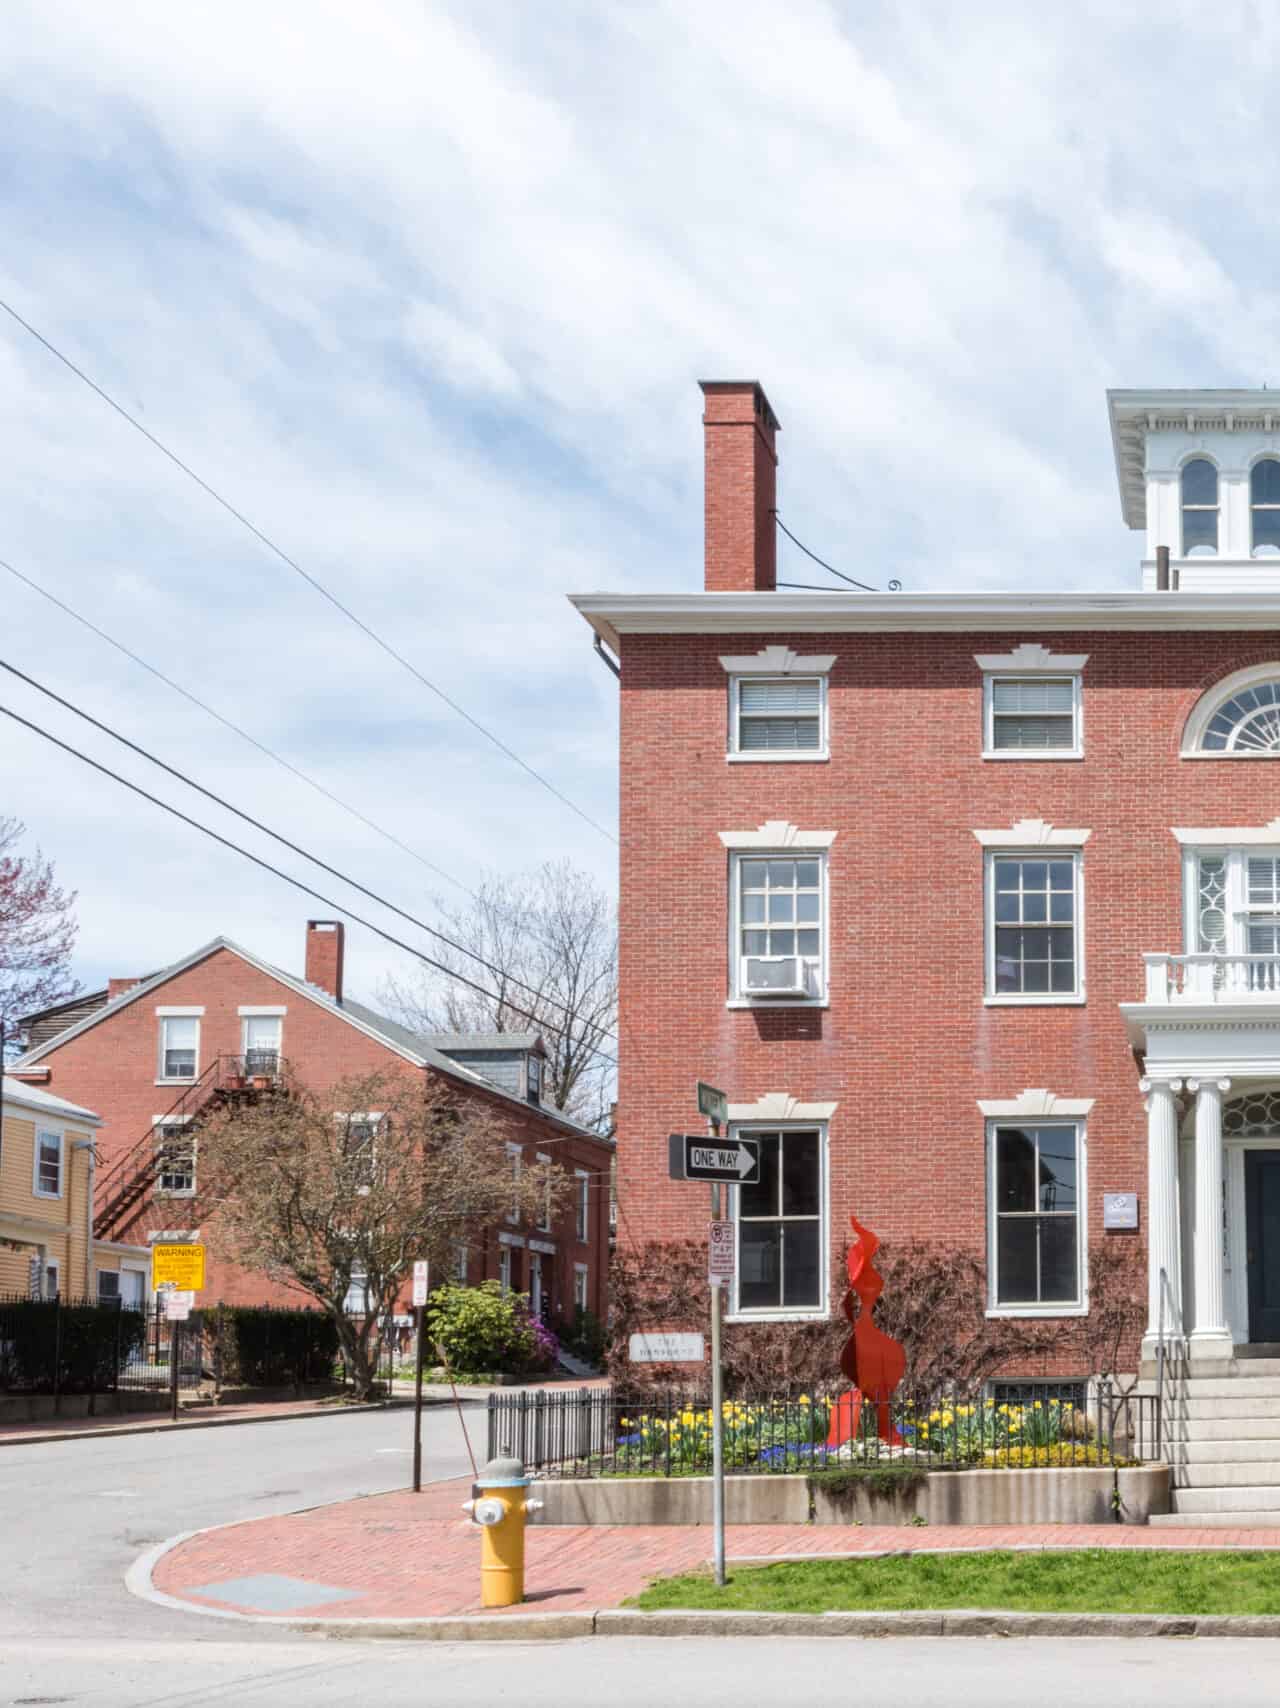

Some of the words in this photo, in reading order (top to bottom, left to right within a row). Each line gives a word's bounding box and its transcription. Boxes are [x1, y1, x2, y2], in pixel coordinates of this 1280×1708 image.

[694, 1149, 715, 1167] ONE
[719, 1151, 738, 1168] WAY
[157, 1247, 202, 1257] WARNING
